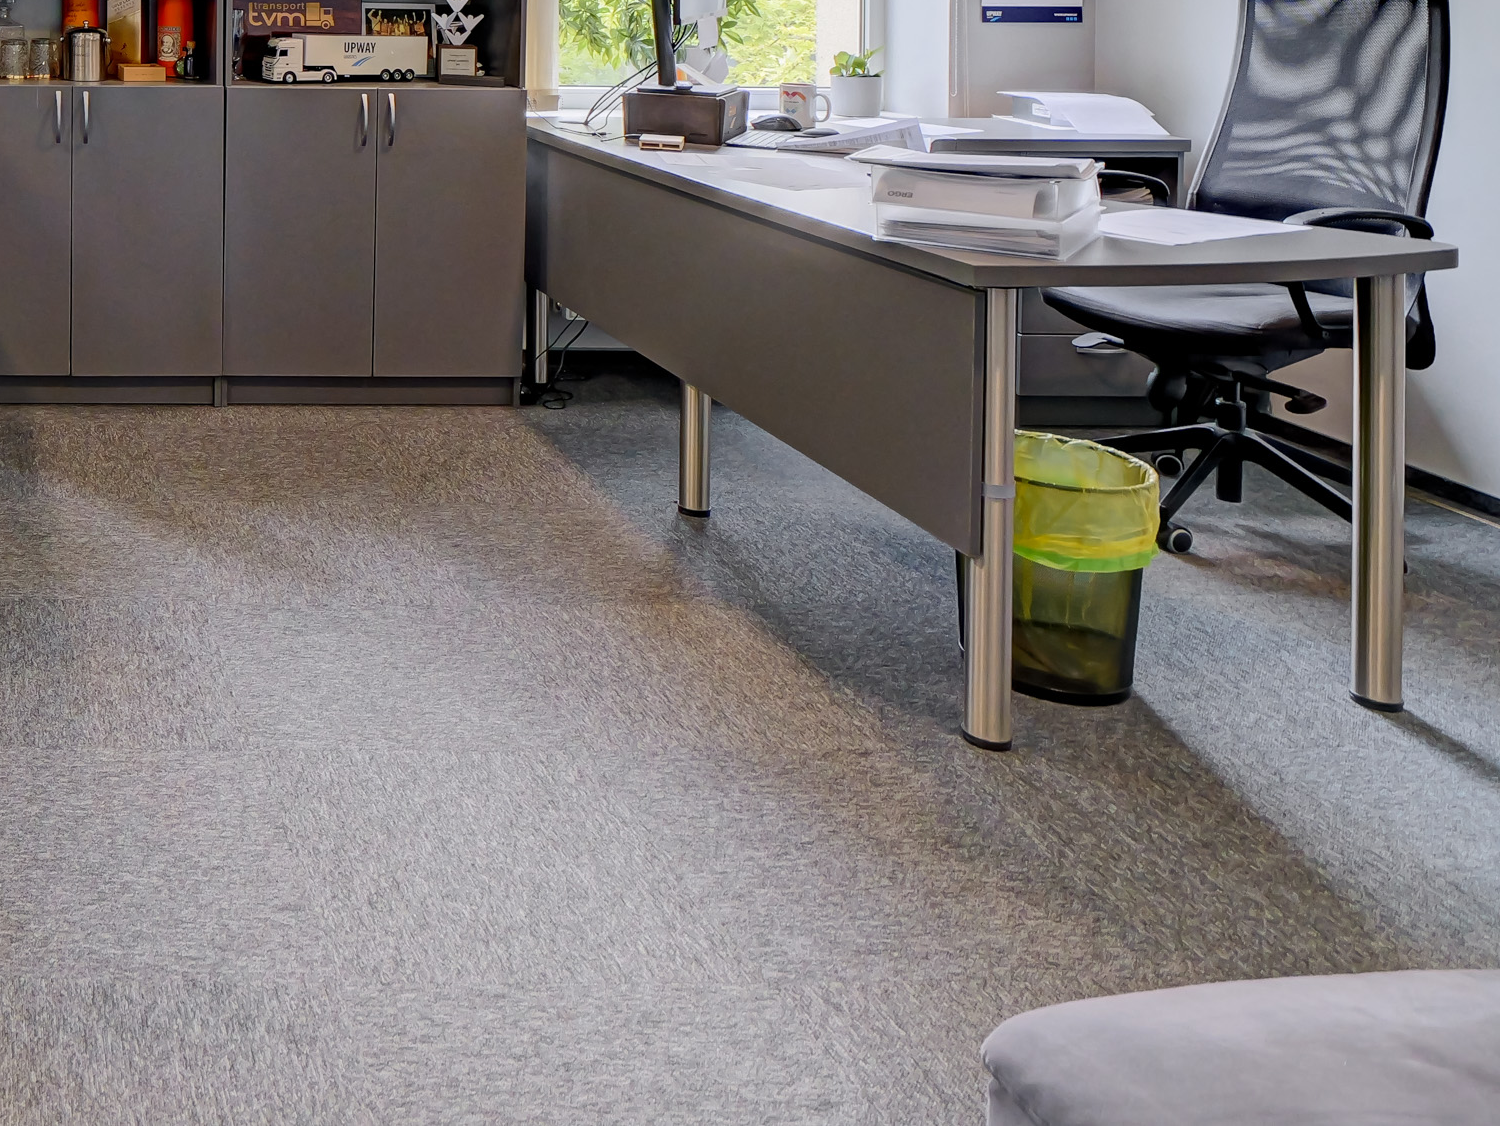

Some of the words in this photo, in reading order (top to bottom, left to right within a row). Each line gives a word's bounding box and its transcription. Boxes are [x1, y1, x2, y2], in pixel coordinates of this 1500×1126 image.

[254, 2, 305, 11] transport
[248, 2, 305, 26] tvm
[344, 42, 376, 53] UPWAY
[887, 190, 914, 198] ERGO
